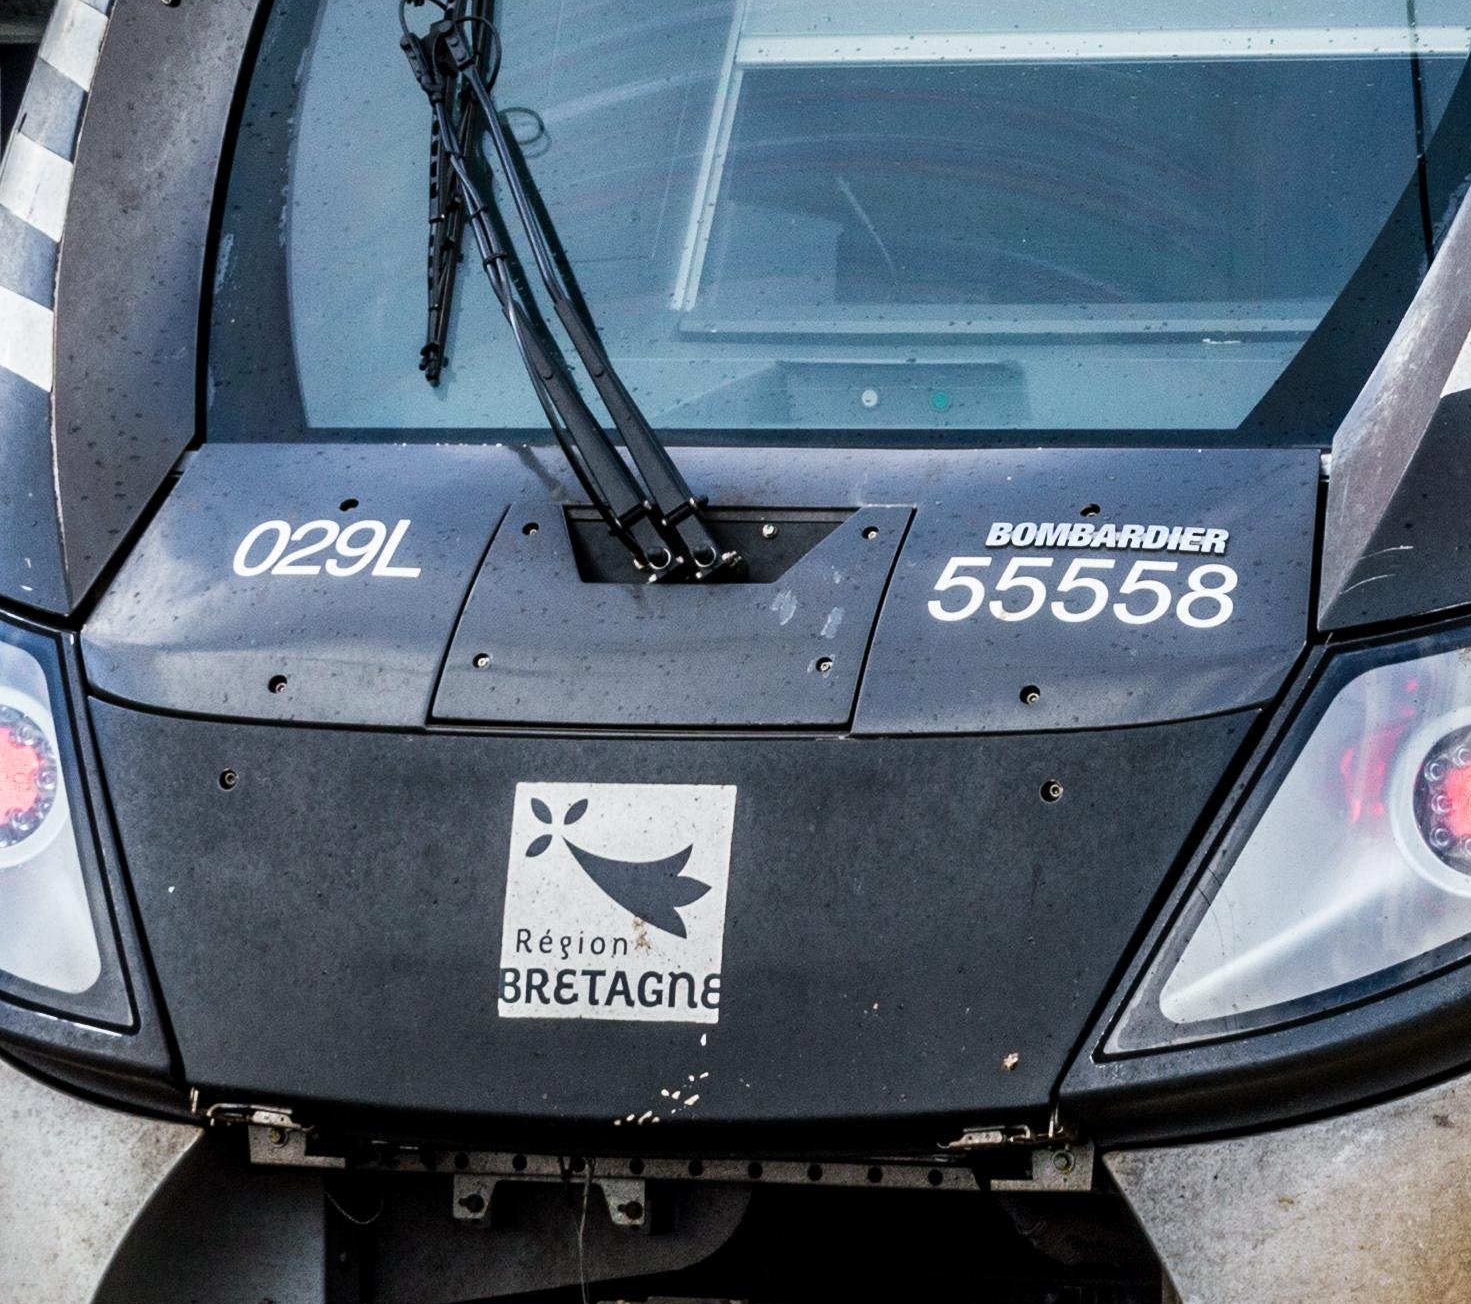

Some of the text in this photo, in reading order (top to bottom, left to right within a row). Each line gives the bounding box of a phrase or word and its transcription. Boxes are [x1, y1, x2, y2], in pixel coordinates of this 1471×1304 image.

[232, 519, 422, 578] 029L
[985, 521, 1230, 554] BOMBARDIER
[927, 556, 1238, 628] 55558
[516, 928, 629, 959] Région
[500, 967, 721, 1010] BRETAGNE
